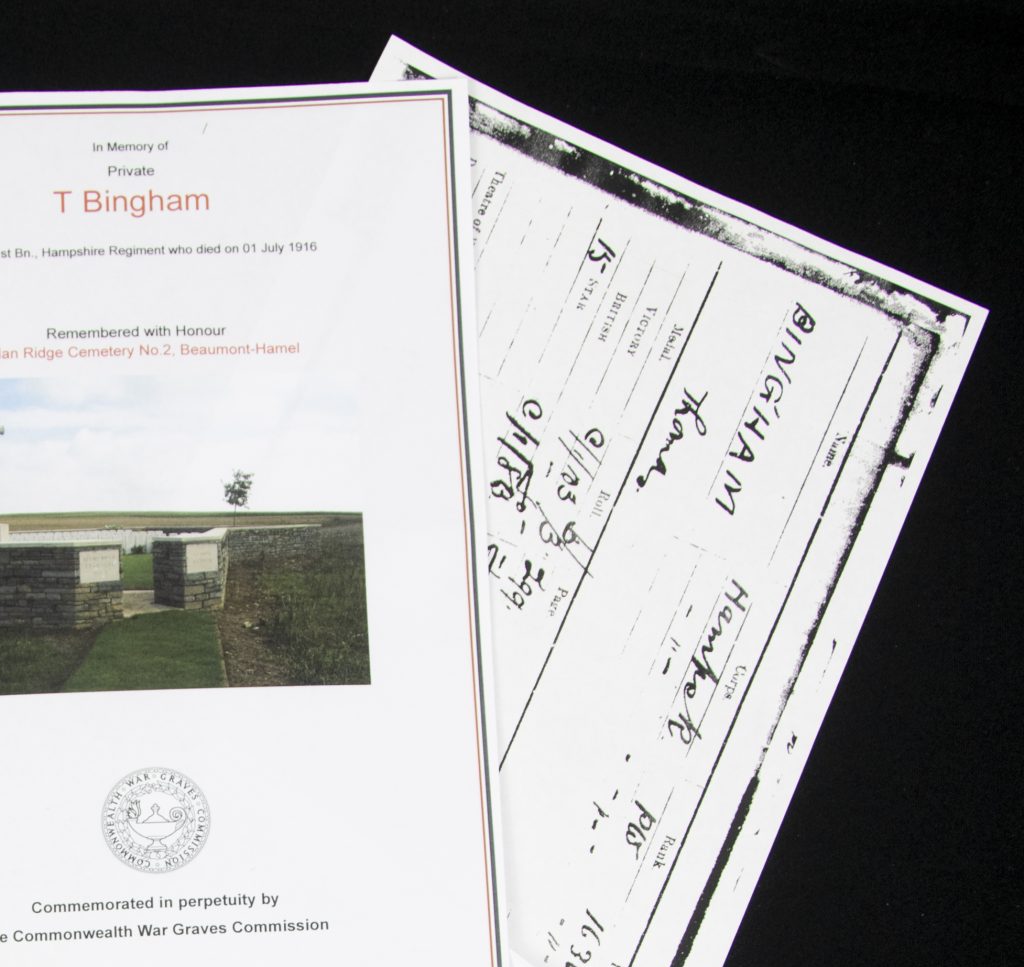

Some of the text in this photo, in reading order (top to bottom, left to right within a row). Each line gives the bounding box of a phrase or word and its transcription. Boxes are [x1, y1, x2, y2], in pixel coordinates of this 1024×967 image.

[92, 140, 169, 154] In Memory of
[107, 164, 155, 177] Private
[53, 189, 211, 218] T Bingham
[477, 171, 507, 216] Theatre
[14, 247, 38, 261] Bn.,
[42, 245, 105, 261] Hampshire
[109, 243, 165, 259] Regiment
[168, 244, 193, 255] who
[196, 243, 221, 255] died
[225, 245, 239, 255] on
[242, 242, 257, 254] 01
[260, 242, 285, 256] July
[288, 241, 318, 252] 1916
[576, 277, 599, 311] STAR
[46, 323, 226, 340] Remembered with Honour
[597, 291, 628, 343] BRITISH
[626, 307, 657, 357] VICTORY
[23, 345, 63, 362] Ridge
[68, 343, 135, 361] Cemetery
[139, 343, 174, 359] No.2,
[180, 340, 300, 356] Beaumont-Hamel
[714, 301, 817, 516] BINGHAM
[822, 432, 847, 468] Name.
[106, 773, 206, 868] COMMONWEALTH WAR GRAVES COMMISSION
[31, 892, 279, 914] Commemorated in perpetuity by
[13, 924, 132, 942] Commonwealth
[138, 923, 169, 938] War
[172, 921, 227, 937] Graves
[232, 918, 329, 934] Commission
